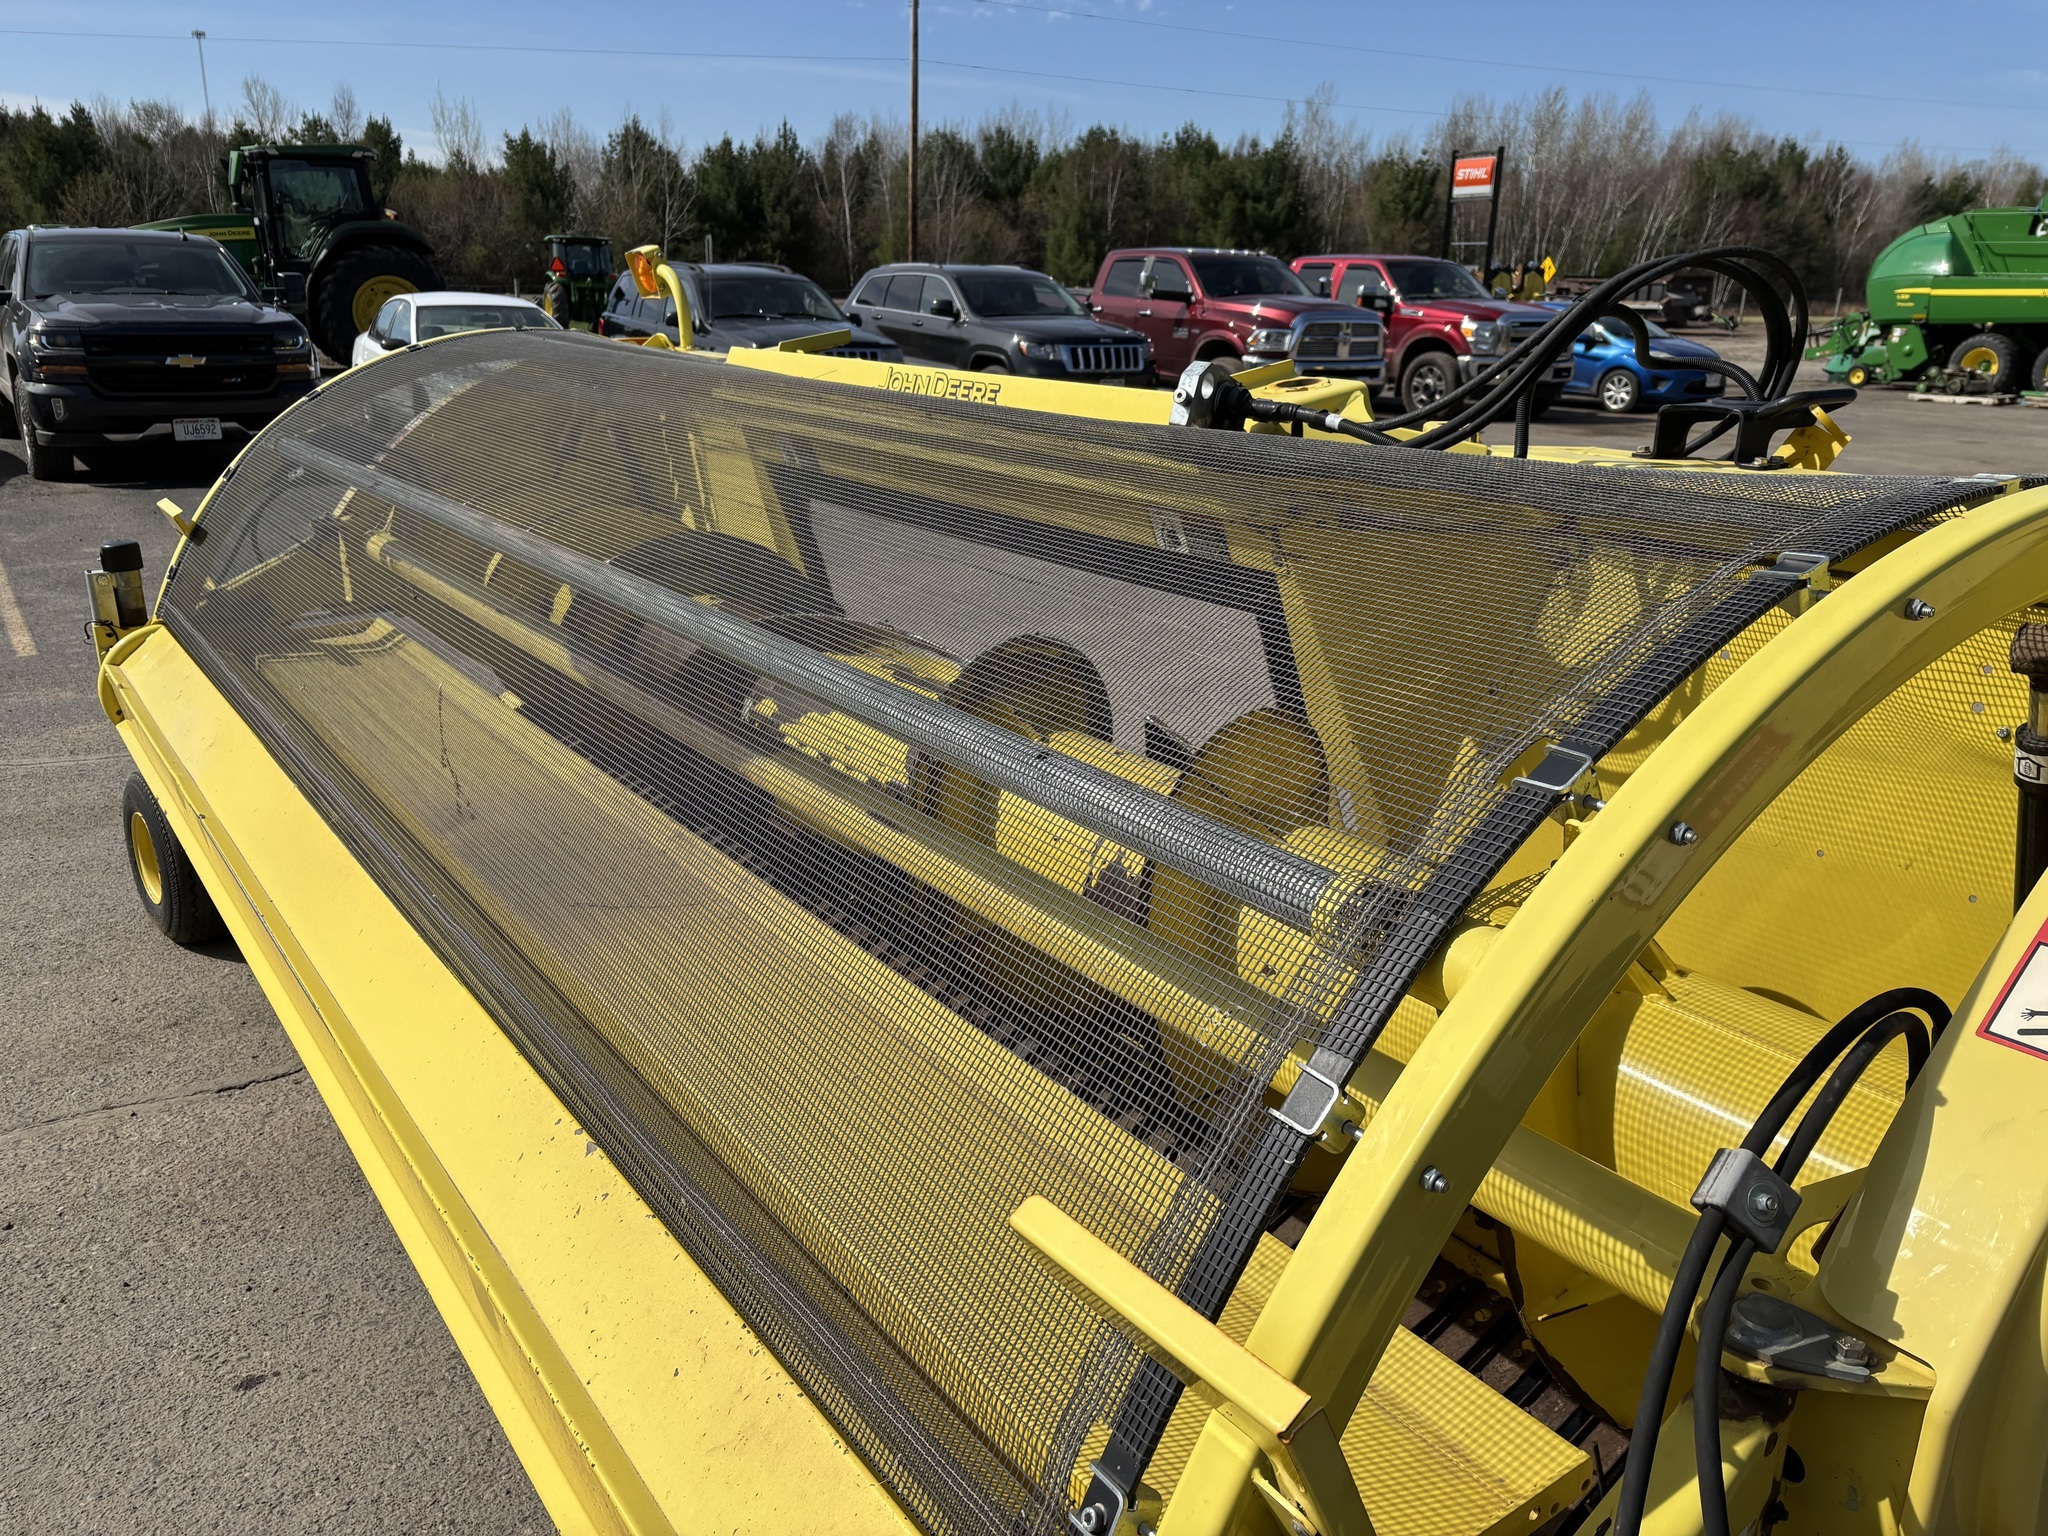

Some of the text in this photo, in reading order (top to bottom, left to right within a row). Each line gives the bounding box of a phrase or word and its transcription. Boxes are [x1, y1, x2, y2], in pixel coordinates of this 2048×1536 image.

[1456, 167, 1488, 180] STIHL
[878, 366, 1001, 405] JOHN DEERE
[183, 423, 217, 436] UJ6592
